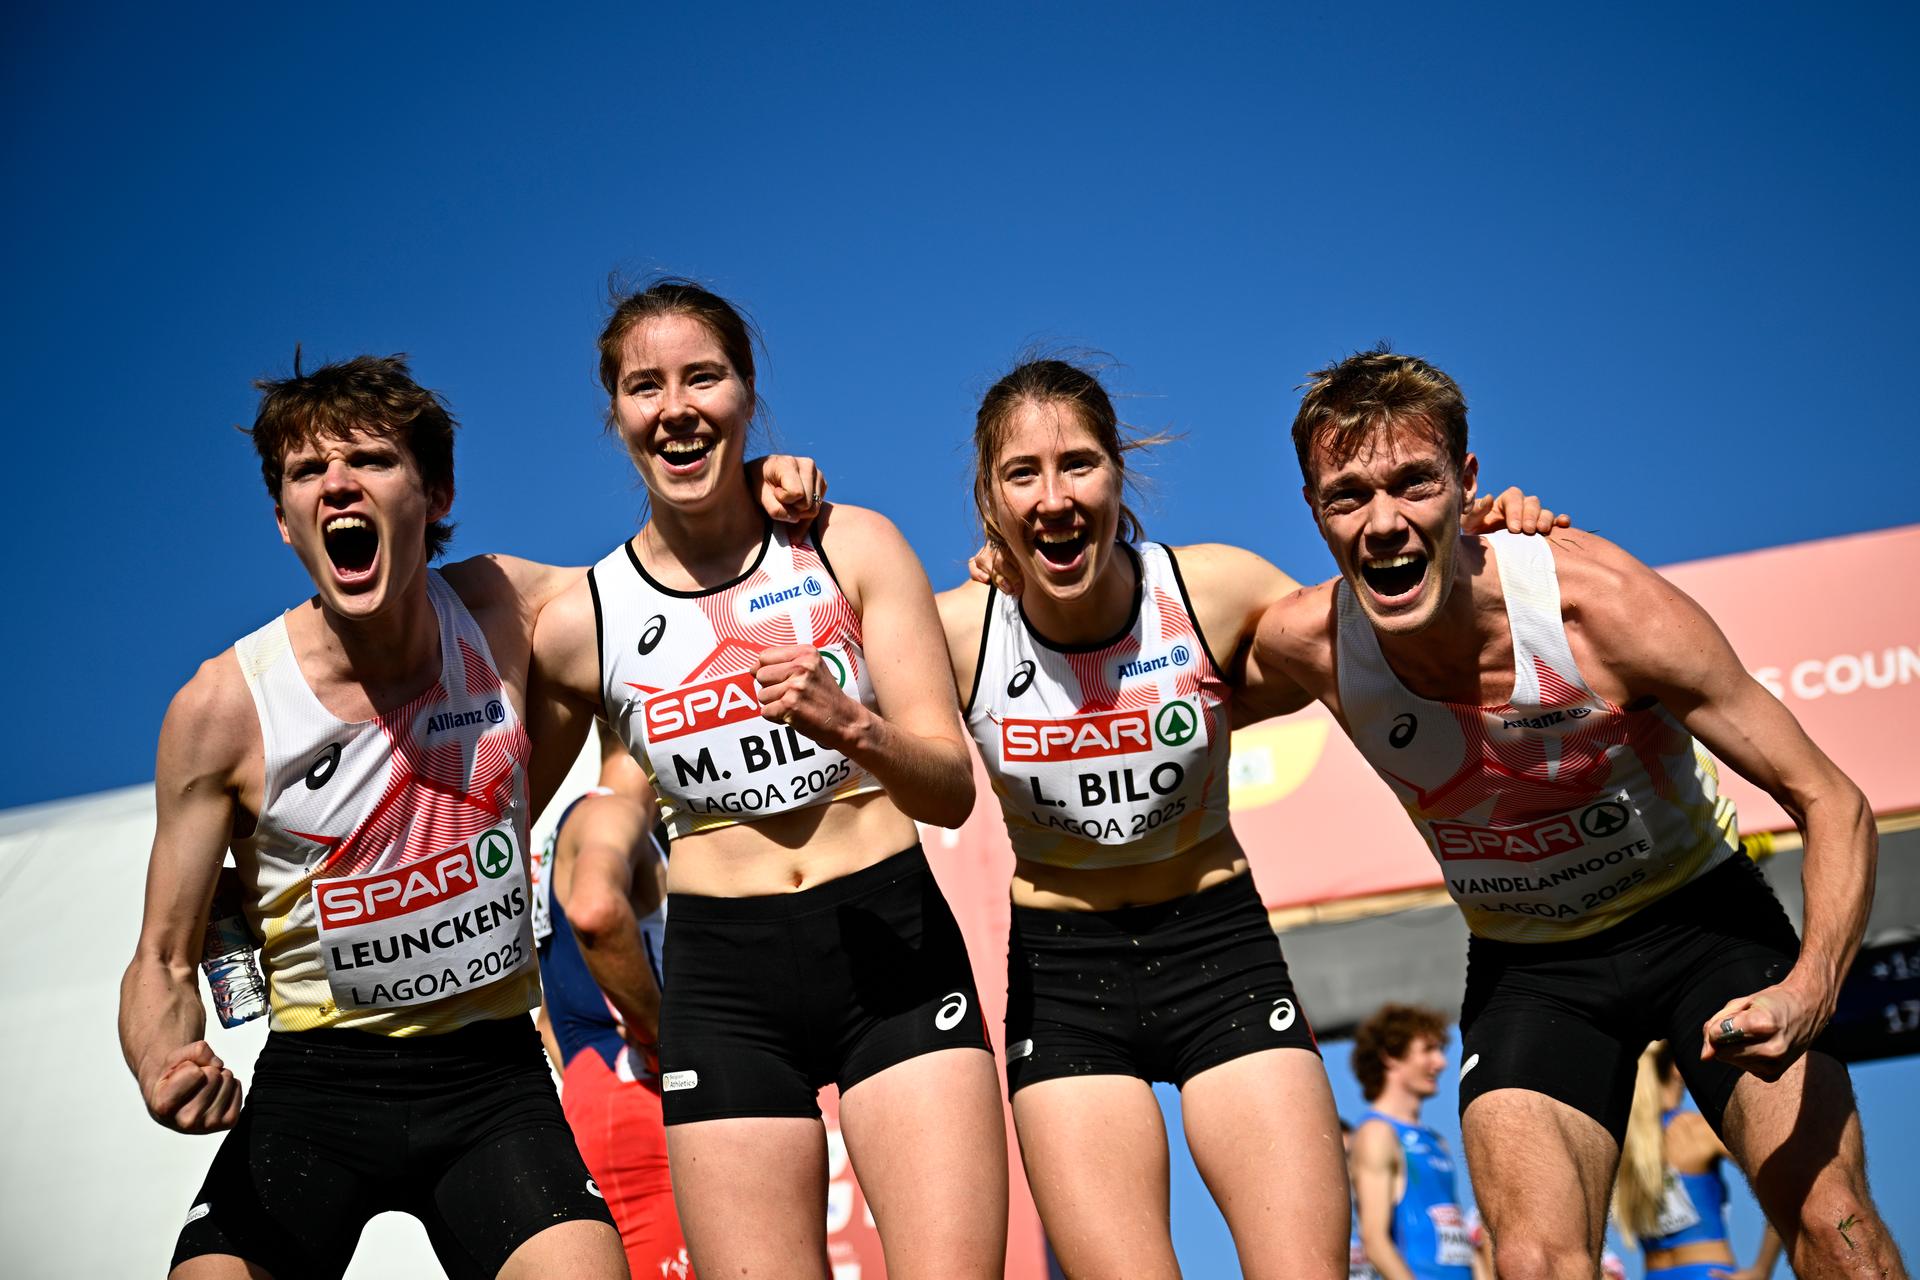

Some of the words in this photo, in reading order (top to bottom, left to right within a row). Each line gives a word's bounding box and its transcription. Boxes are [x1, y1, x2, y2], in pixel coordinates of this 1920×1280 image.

[749, 585, 802, 612] Allianz
[1117, 656, 1169, 680] Allianz
[426, 708, 484, 735] Allianz
[649, 679, 764, 735] SPA
[671, 747, 732, 788] M.
[739, 725, 832, 773] BIL
[1006, 717, 1147, 756] SPAR
[687, 783, 787, 814] LAGOA
[790, 758, 851, 800] 2025
[1029, 777, 1067, 808] L.
[1078, 762, 1185, 807] BILO
[1032, 811, 1125, 839] LAGOA
[1131, 796, 1188, 836] 2025
[1439, 821, 1577, 857] SPAR
[323, 853, 473, 923] SPAR
[1451, 839, 1651, 895] VANDELANNOOTE
[1481, 902, 1580, 919] LAGOA
[1581, 869, 1647, 910] 2025
[331, 887, 526, 972] LEUNCKENS
[351, 968, 462, 1007] LAGOA
[467, 937, 523, 982] 2025
